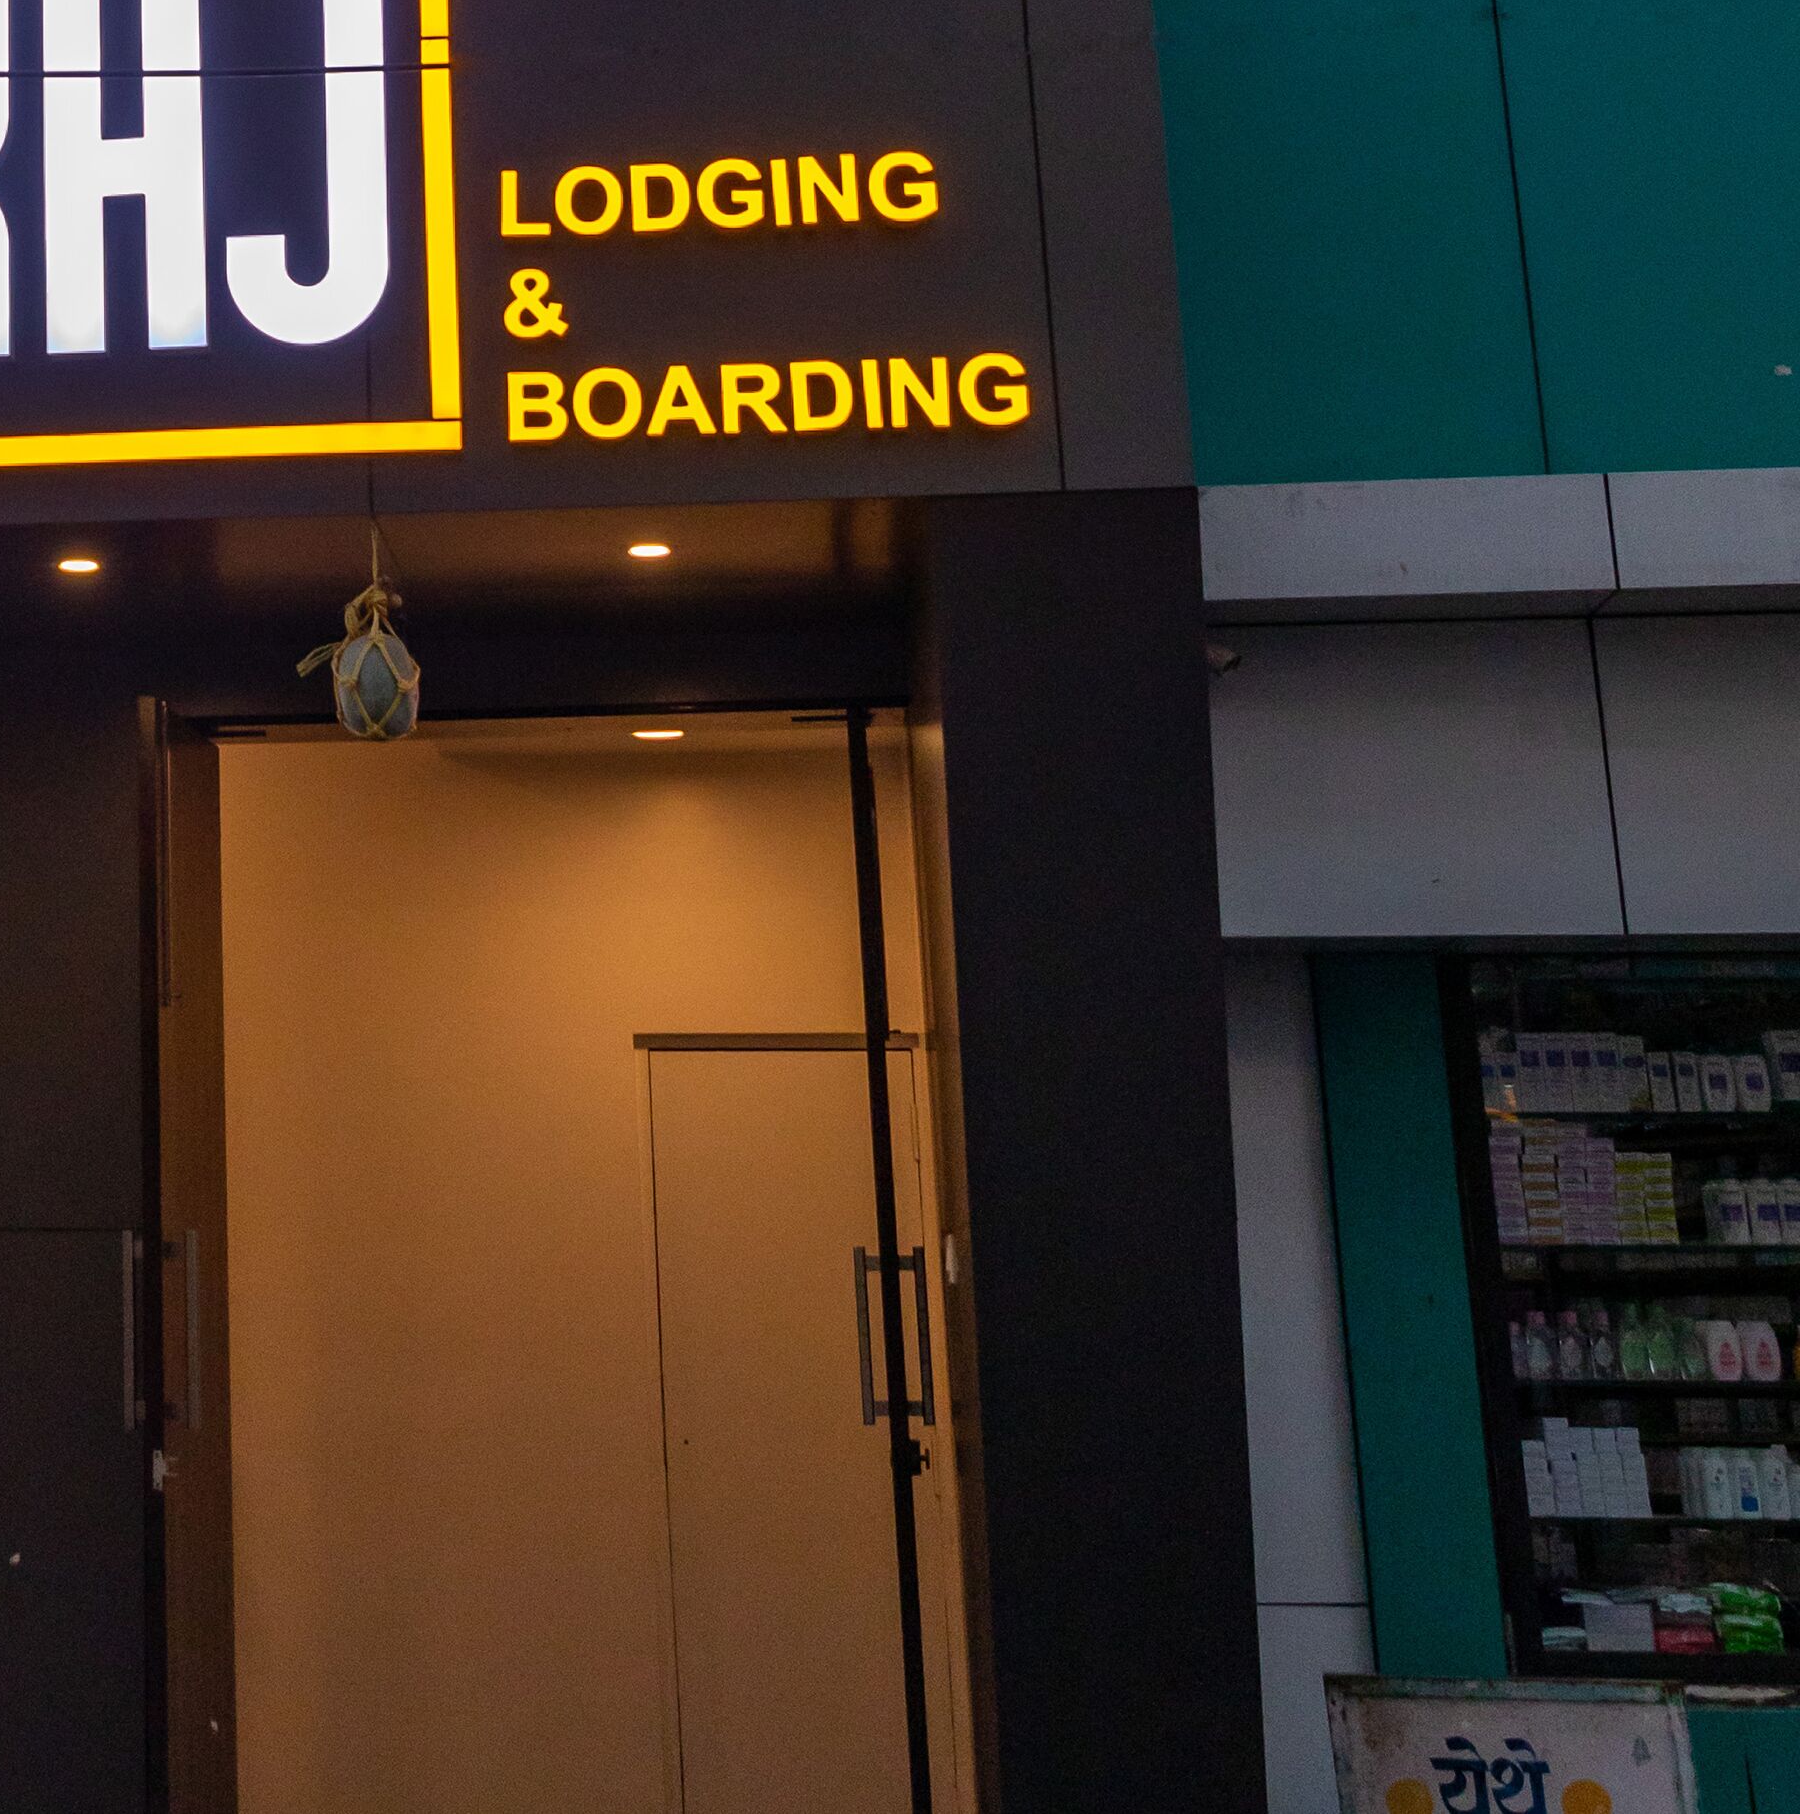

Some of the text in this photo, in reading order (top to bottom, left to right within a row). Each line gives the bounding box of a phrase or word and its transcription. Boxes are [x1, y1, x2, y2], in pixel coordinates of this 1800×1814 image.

[500, 151, 939, 237] LODGING
[503, 268, 569, 339] &
[507, 352, 1031, 443] BOARDING
[1430, 1735, 1551, 1814] येथे
